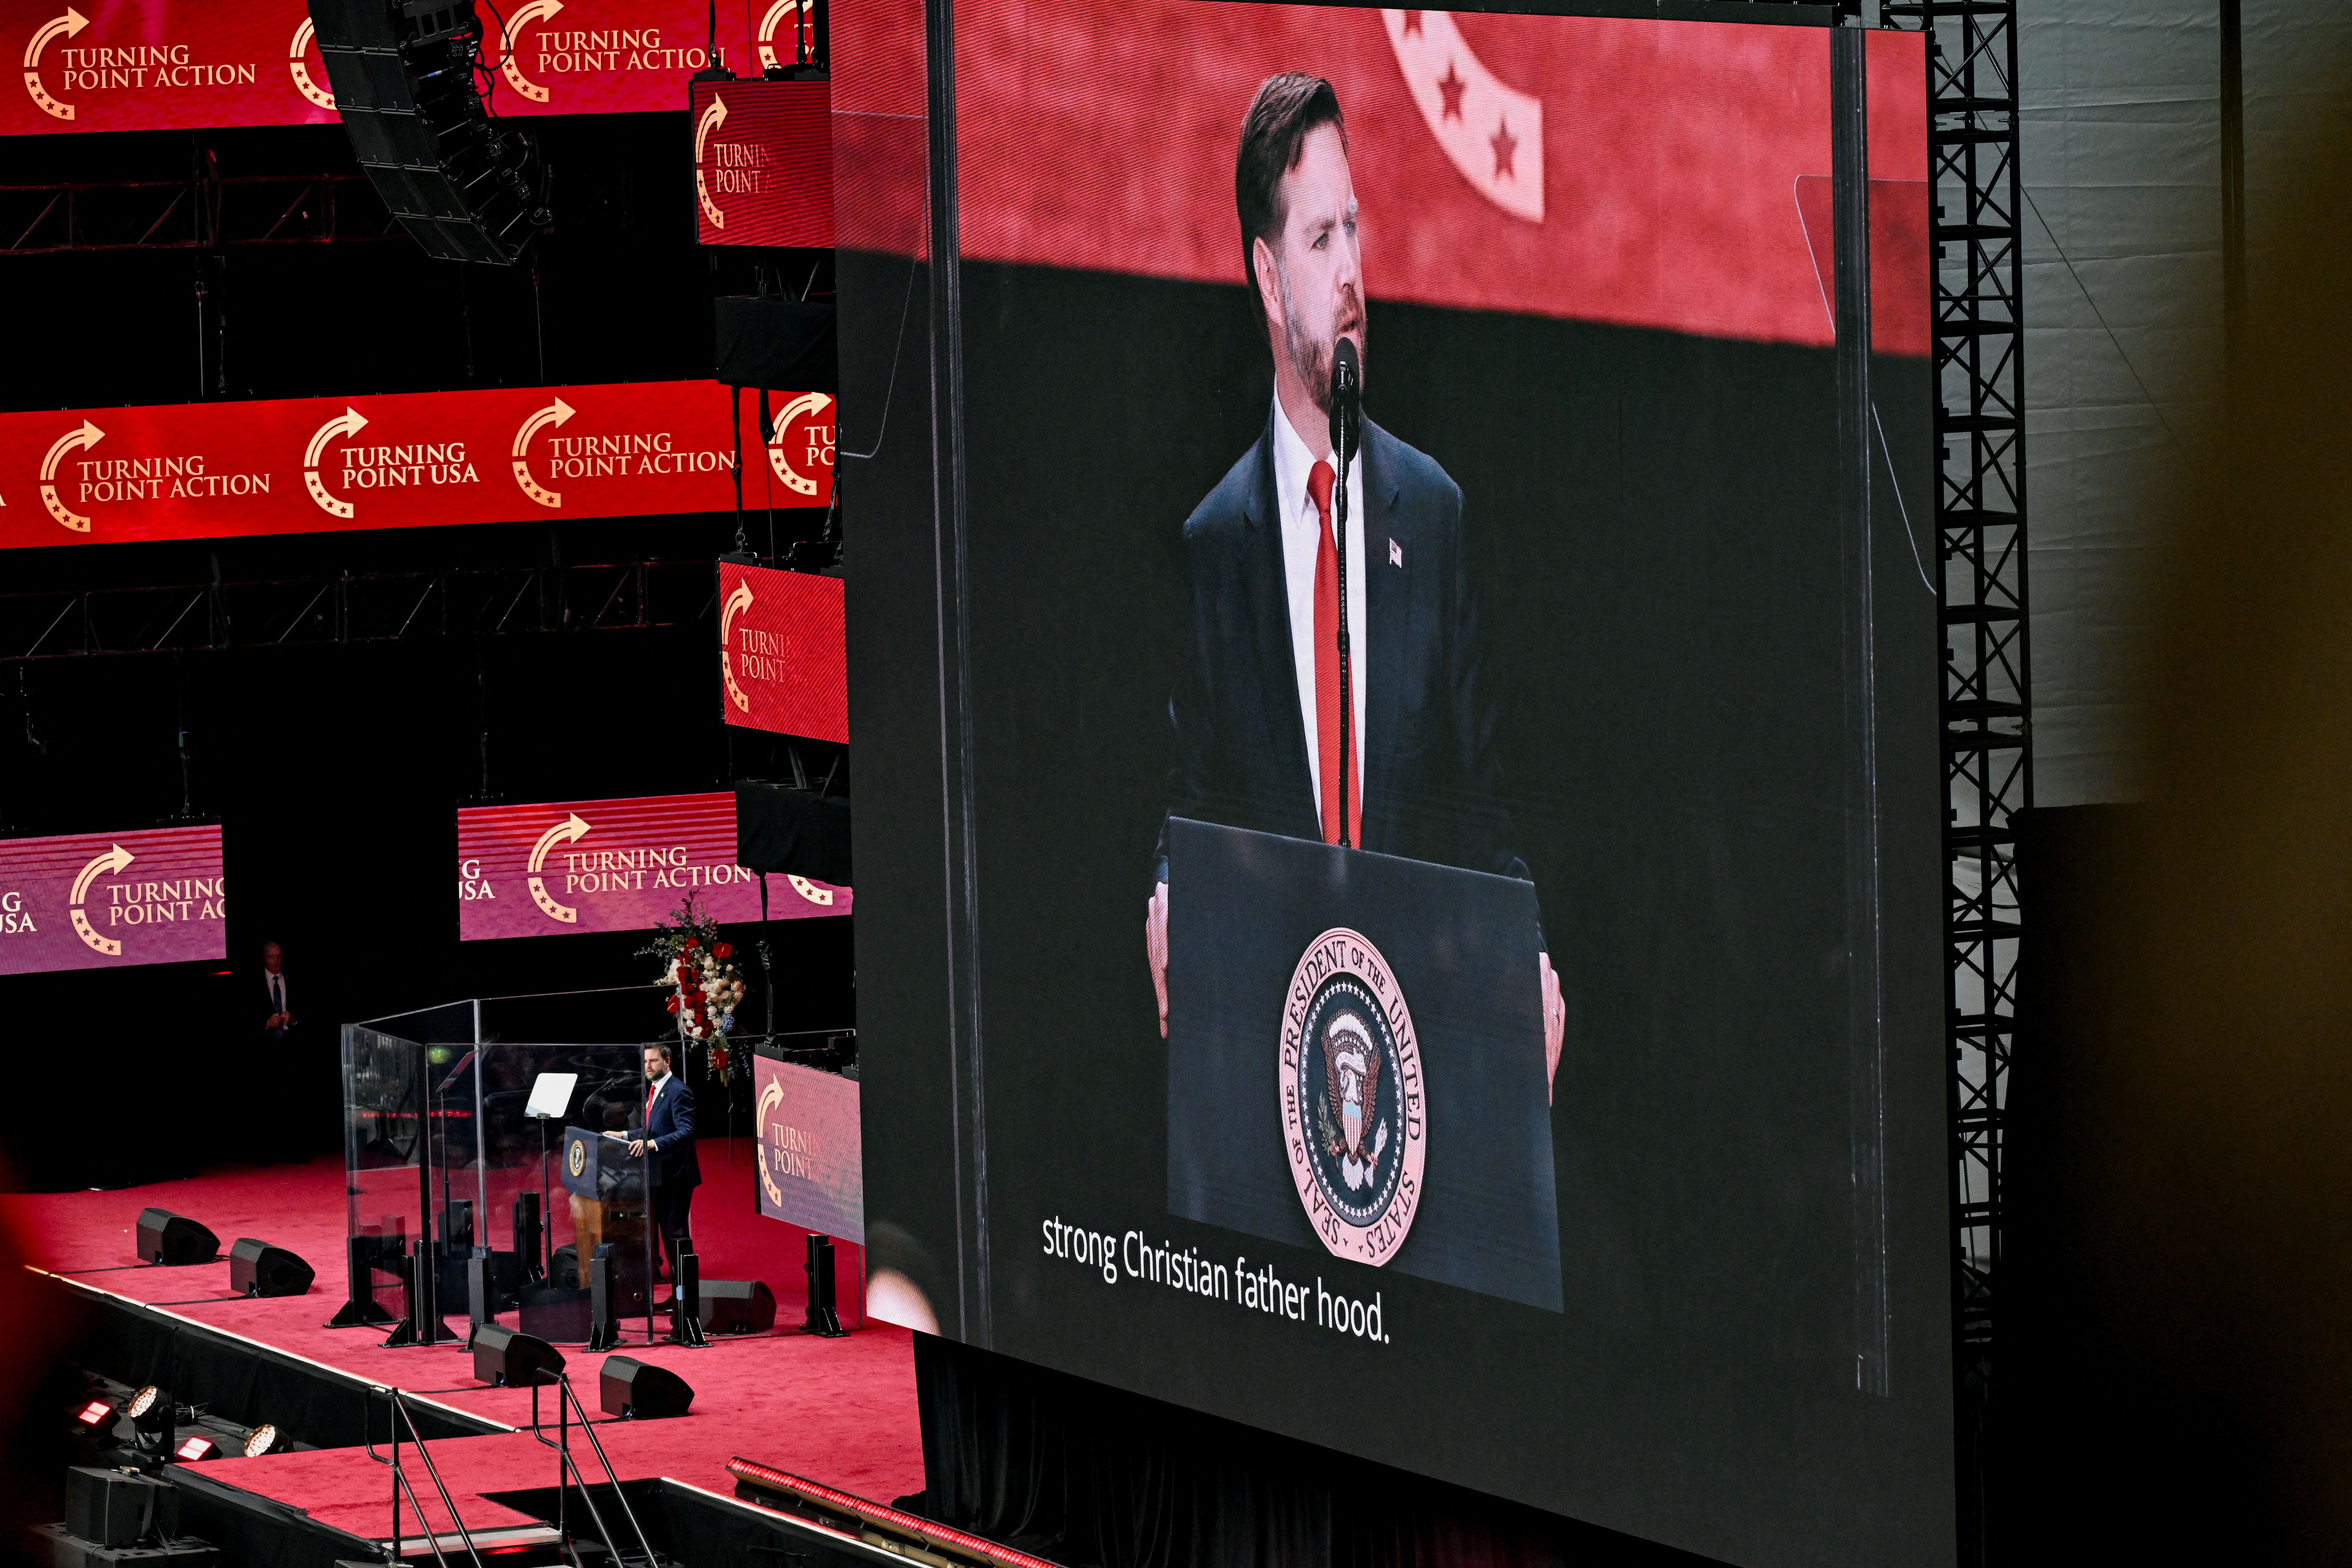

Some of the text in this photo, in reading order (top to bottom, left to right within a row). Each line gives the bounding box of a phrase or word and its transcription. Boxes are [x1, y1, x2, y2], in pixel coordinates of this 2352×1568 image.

[537, 29, 661, 51] TURNING
[62, 45, 189, 68] TURNING
[538, 51, 620, 73] POINT
[64, 64, 255, 90] POINT ACTION
[715, 169, 760, 193] POINT
[341, 443, 465, 467] TURNING
[549, 433, 672, 457] TURNING
[77, 456, 204, 481] TURNING
[342, 463, 480, 489] POINT USA
[551, 451, 736, 478] POINT ACTION
[81, 474, 270, 502] POINT ACTION
[741, 654, 786, 682] POINT
[564, 847, 687, 872] TURNING
[567, 864, 750, 895] POINT ACTION
[0, 912, 37, 933] SA
[110, 901, 193, 926] POINT
[1285, 941, 1421, 1258] SEAL OF THE PRESIDENT OF THE UNITED STATES
[774, 1148, 812, 1180] POINT
[1043, 1216, 1389, 1344] strong Christian father hood.
